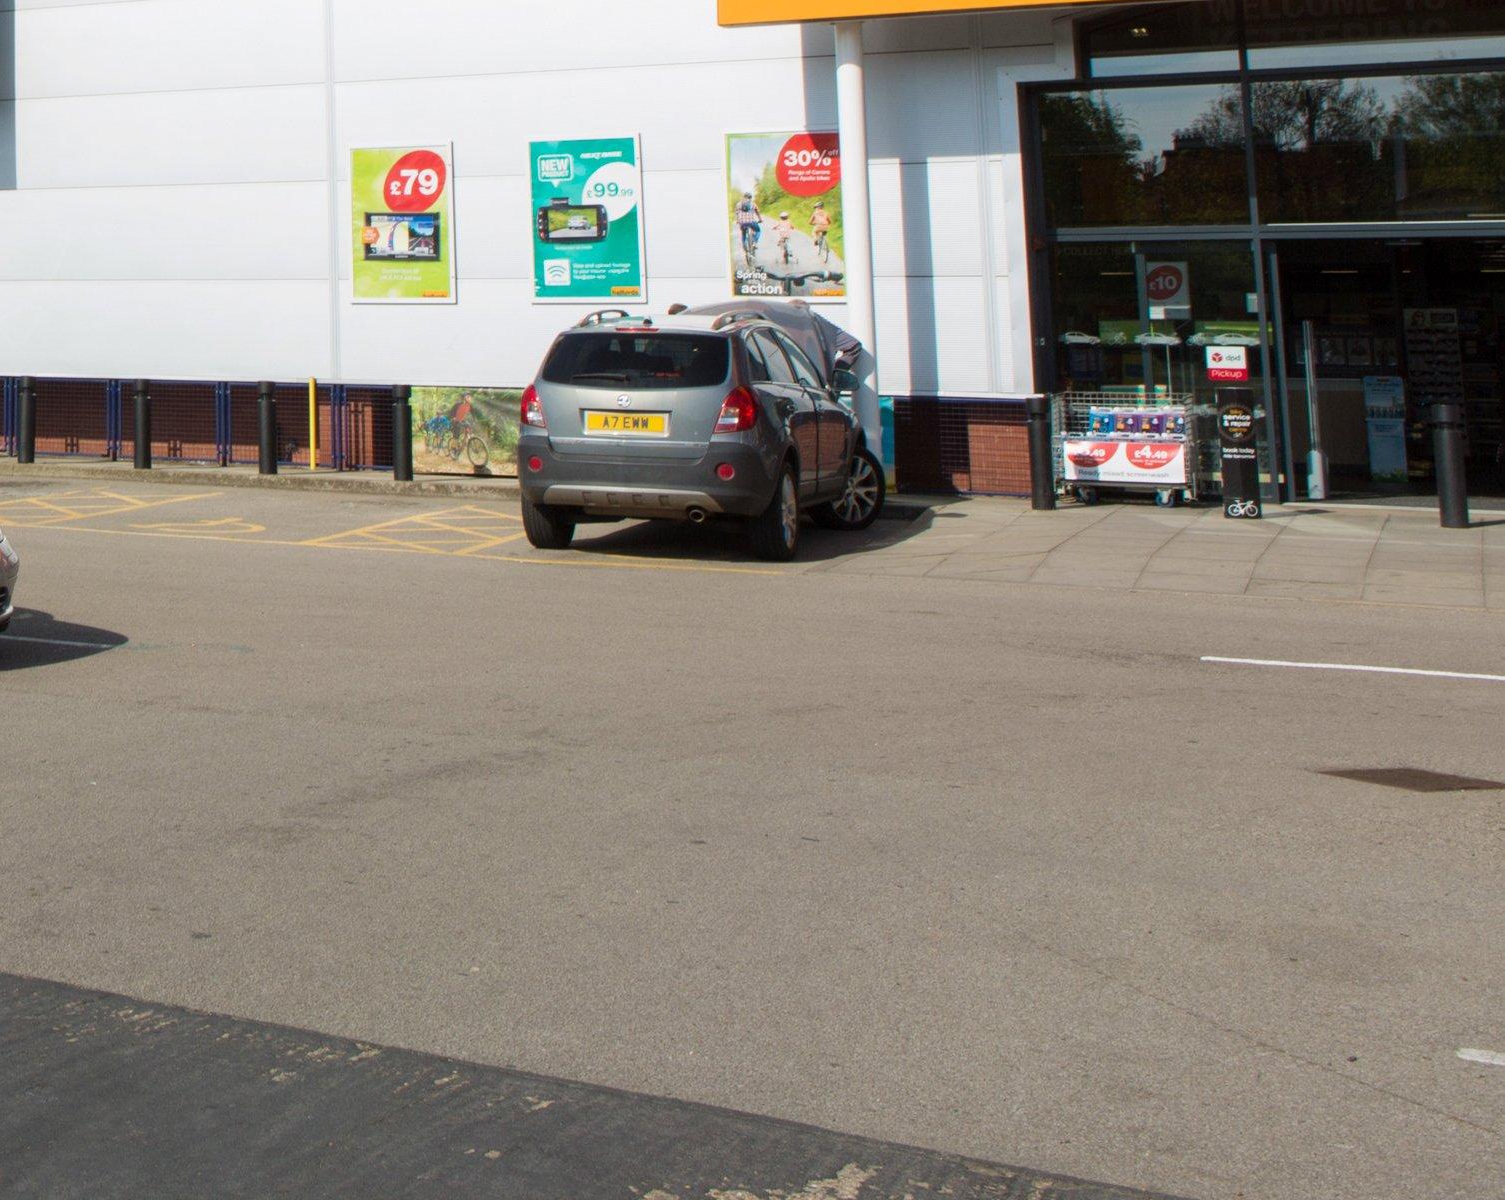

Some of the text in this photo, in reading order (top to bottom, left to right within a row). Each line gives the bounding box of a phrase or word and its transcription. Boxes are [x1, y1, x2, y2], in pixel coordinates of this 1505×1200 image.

[783, 149, 832, 167] 30%
[541, 158, 569, 171] NEW
[390, 169, 439, 196] £79
[736, 270, 767, 280] Spring
[741, 282, 783, 294] action
[1148, 275, 1178, 291] £10
[1225, 353, 1241, 362] dpd
[1211, 369, 1243, 378] Pickup
[603, 416, 649, 429] A7 EWW
[1230, 420, 1251, 428] repair
